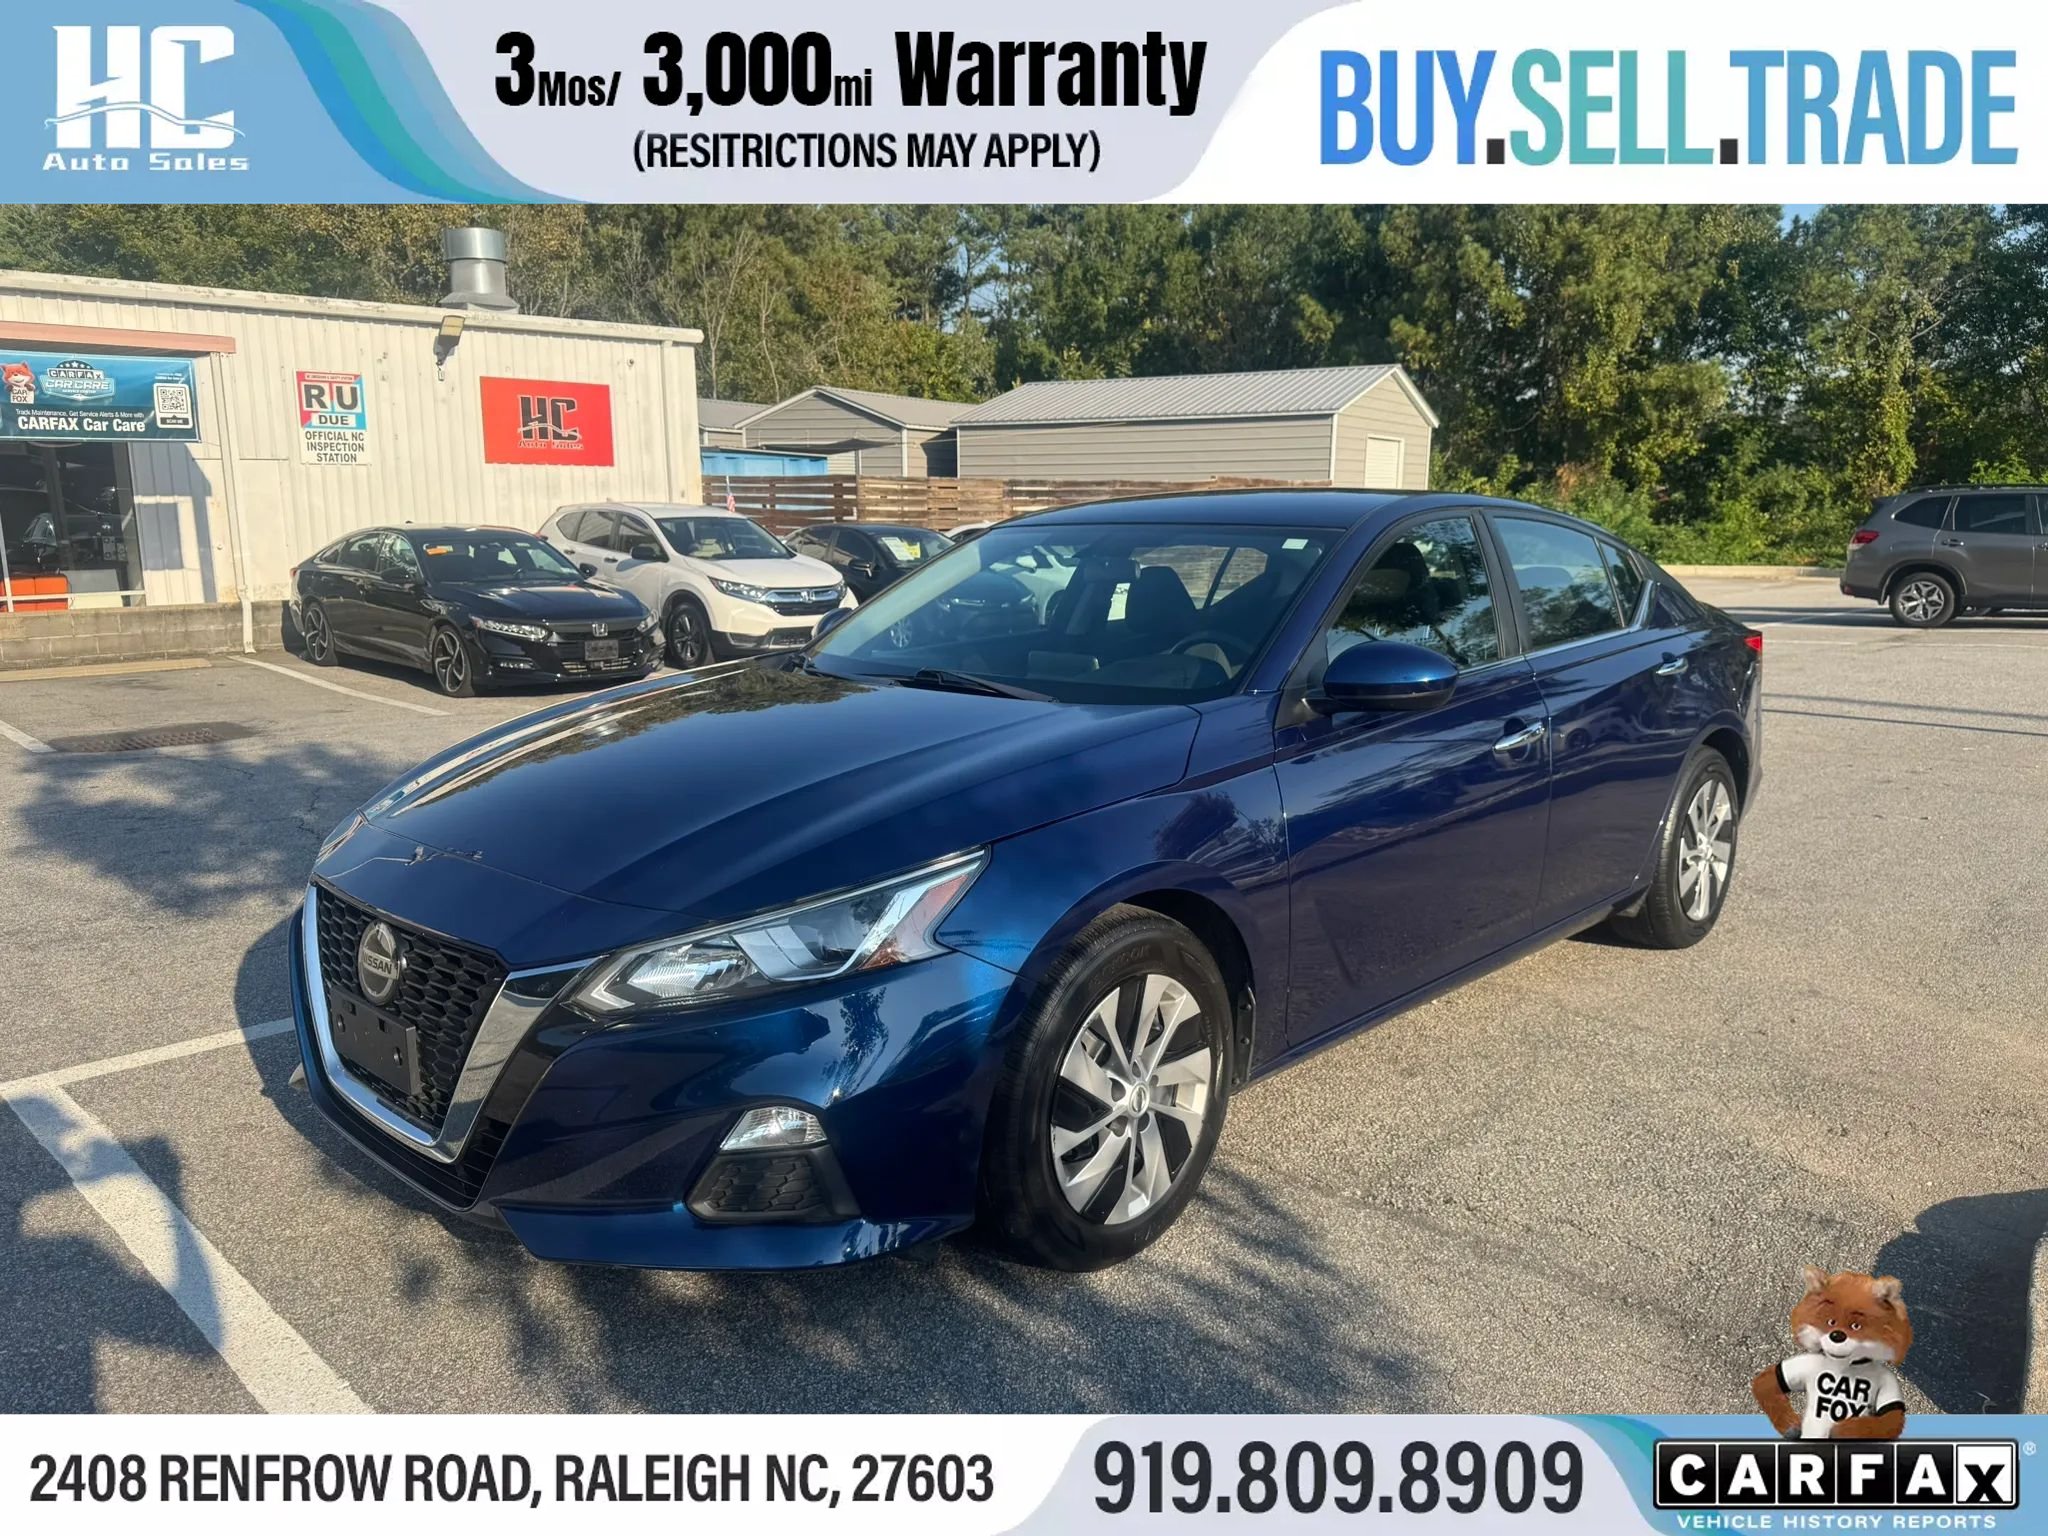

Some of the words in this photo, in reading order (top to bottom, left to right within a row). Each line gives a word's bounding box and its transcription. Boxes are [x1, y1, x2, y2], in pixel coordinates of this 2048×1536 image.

[51, 370, 102, 380] CARFAX
[46, 380, 73, 389] CAR
[74, 381, 110, 390] CARE
[12, 388, 28, 396] CAR
[12, 395, 28, 403] FOX
[318, 415, 349, 425] DUE
[519, 395, 579, 442] HC
[18, 416, 79, 430] CARFAX
[83, 418, 109, 431] Car
[113, 419, 145, 432] Care
[305, 431, 349, 441] OFFICIAL
[351, 432, 364, 441] NC
[307, 442, 364, 452] INSPECTION
[317, 453, 357, 462] STATION
[363, 951, 392, 975] NISSAN
